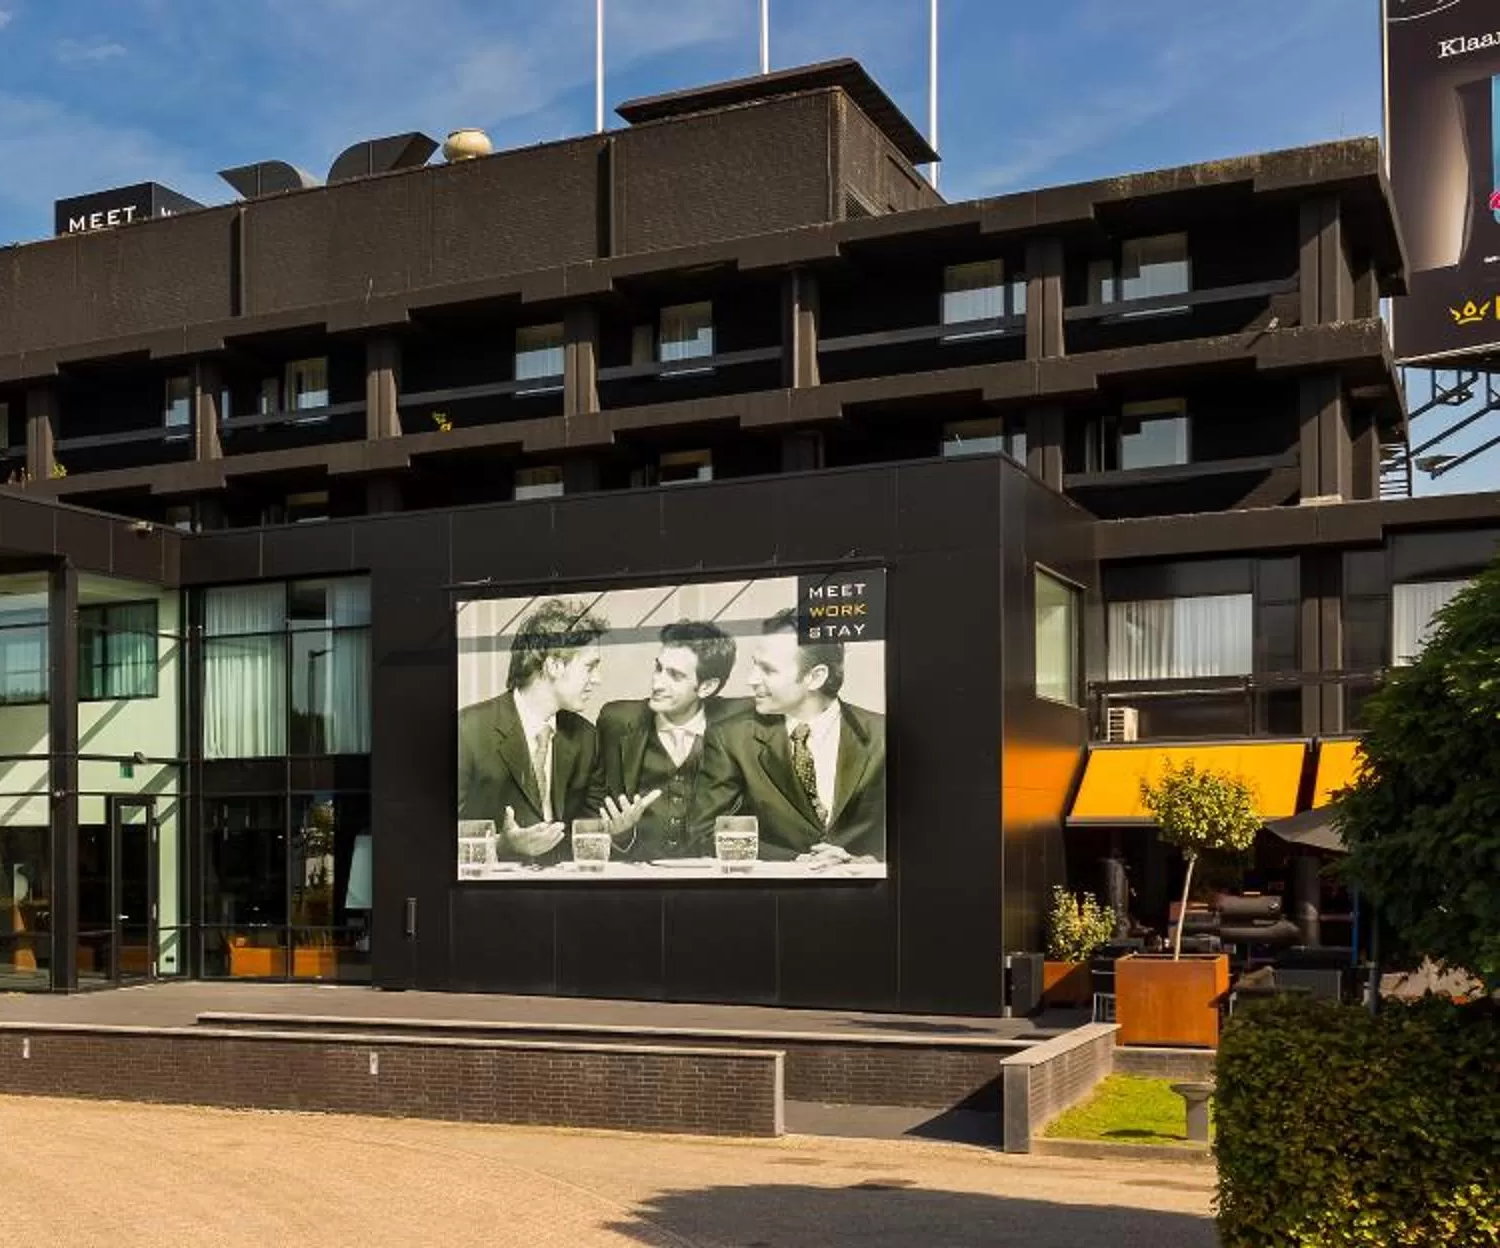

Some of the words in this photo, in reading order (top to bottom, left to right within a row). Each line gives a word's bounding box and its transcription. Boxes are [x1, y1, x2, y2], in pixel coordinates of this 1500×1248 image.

[68, 205, 137, 233] MEET
[809, 583, 867, 599] MEET
[809, 603, 868, 618] WORK
[809, 623, 866, 639] STAY
